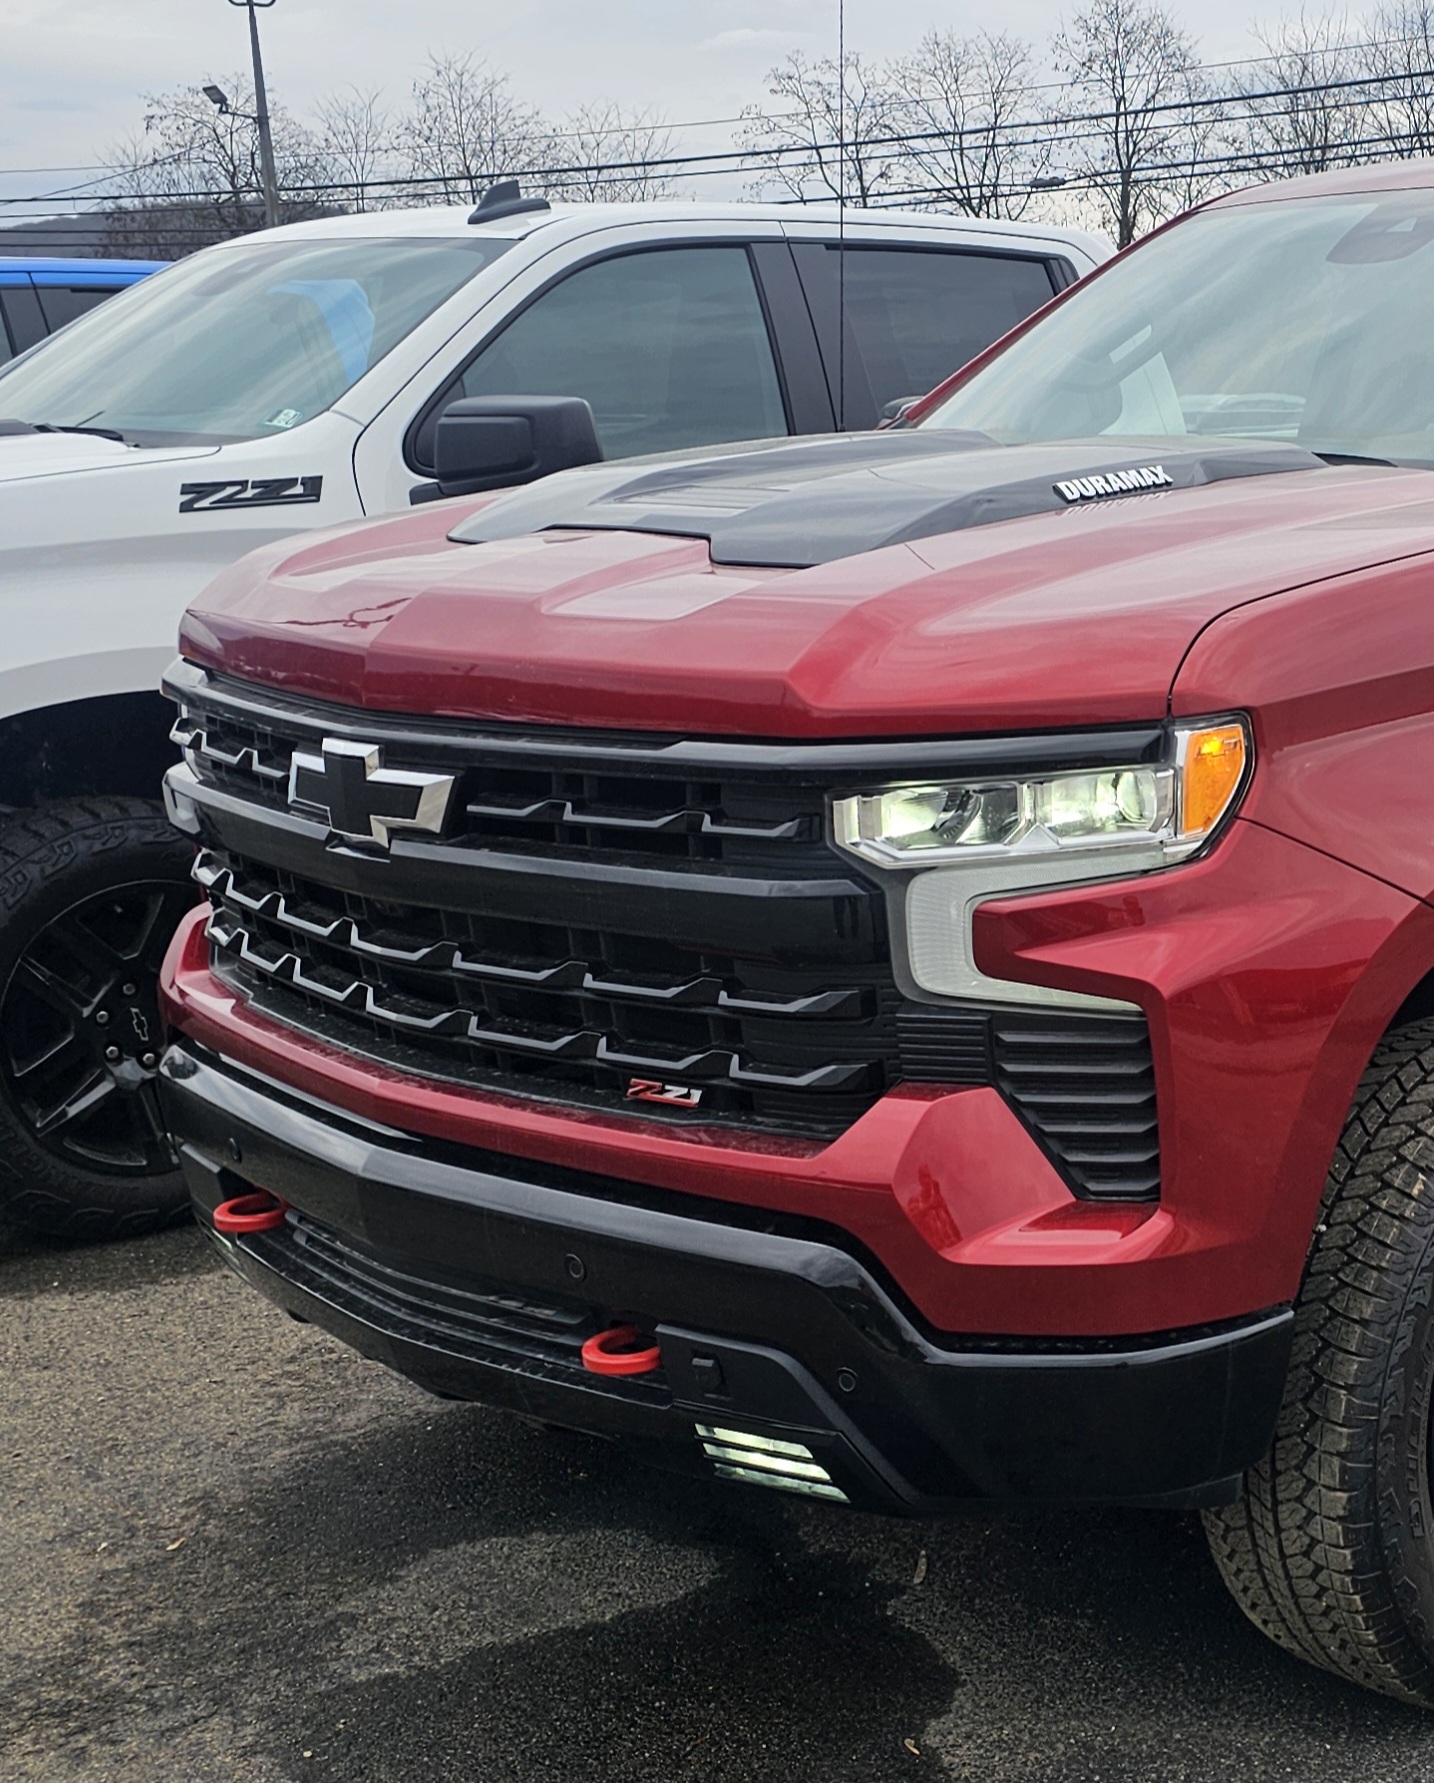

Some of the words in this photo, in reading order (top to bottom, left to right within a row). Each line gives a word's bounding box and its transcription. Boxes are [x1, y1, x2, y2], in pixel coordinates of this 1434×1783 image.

[179, 475, 323, 513] Z71
[1053, 465, 1173, 503] DURAMAX
[626, 1077, 702, 1108] Z71
